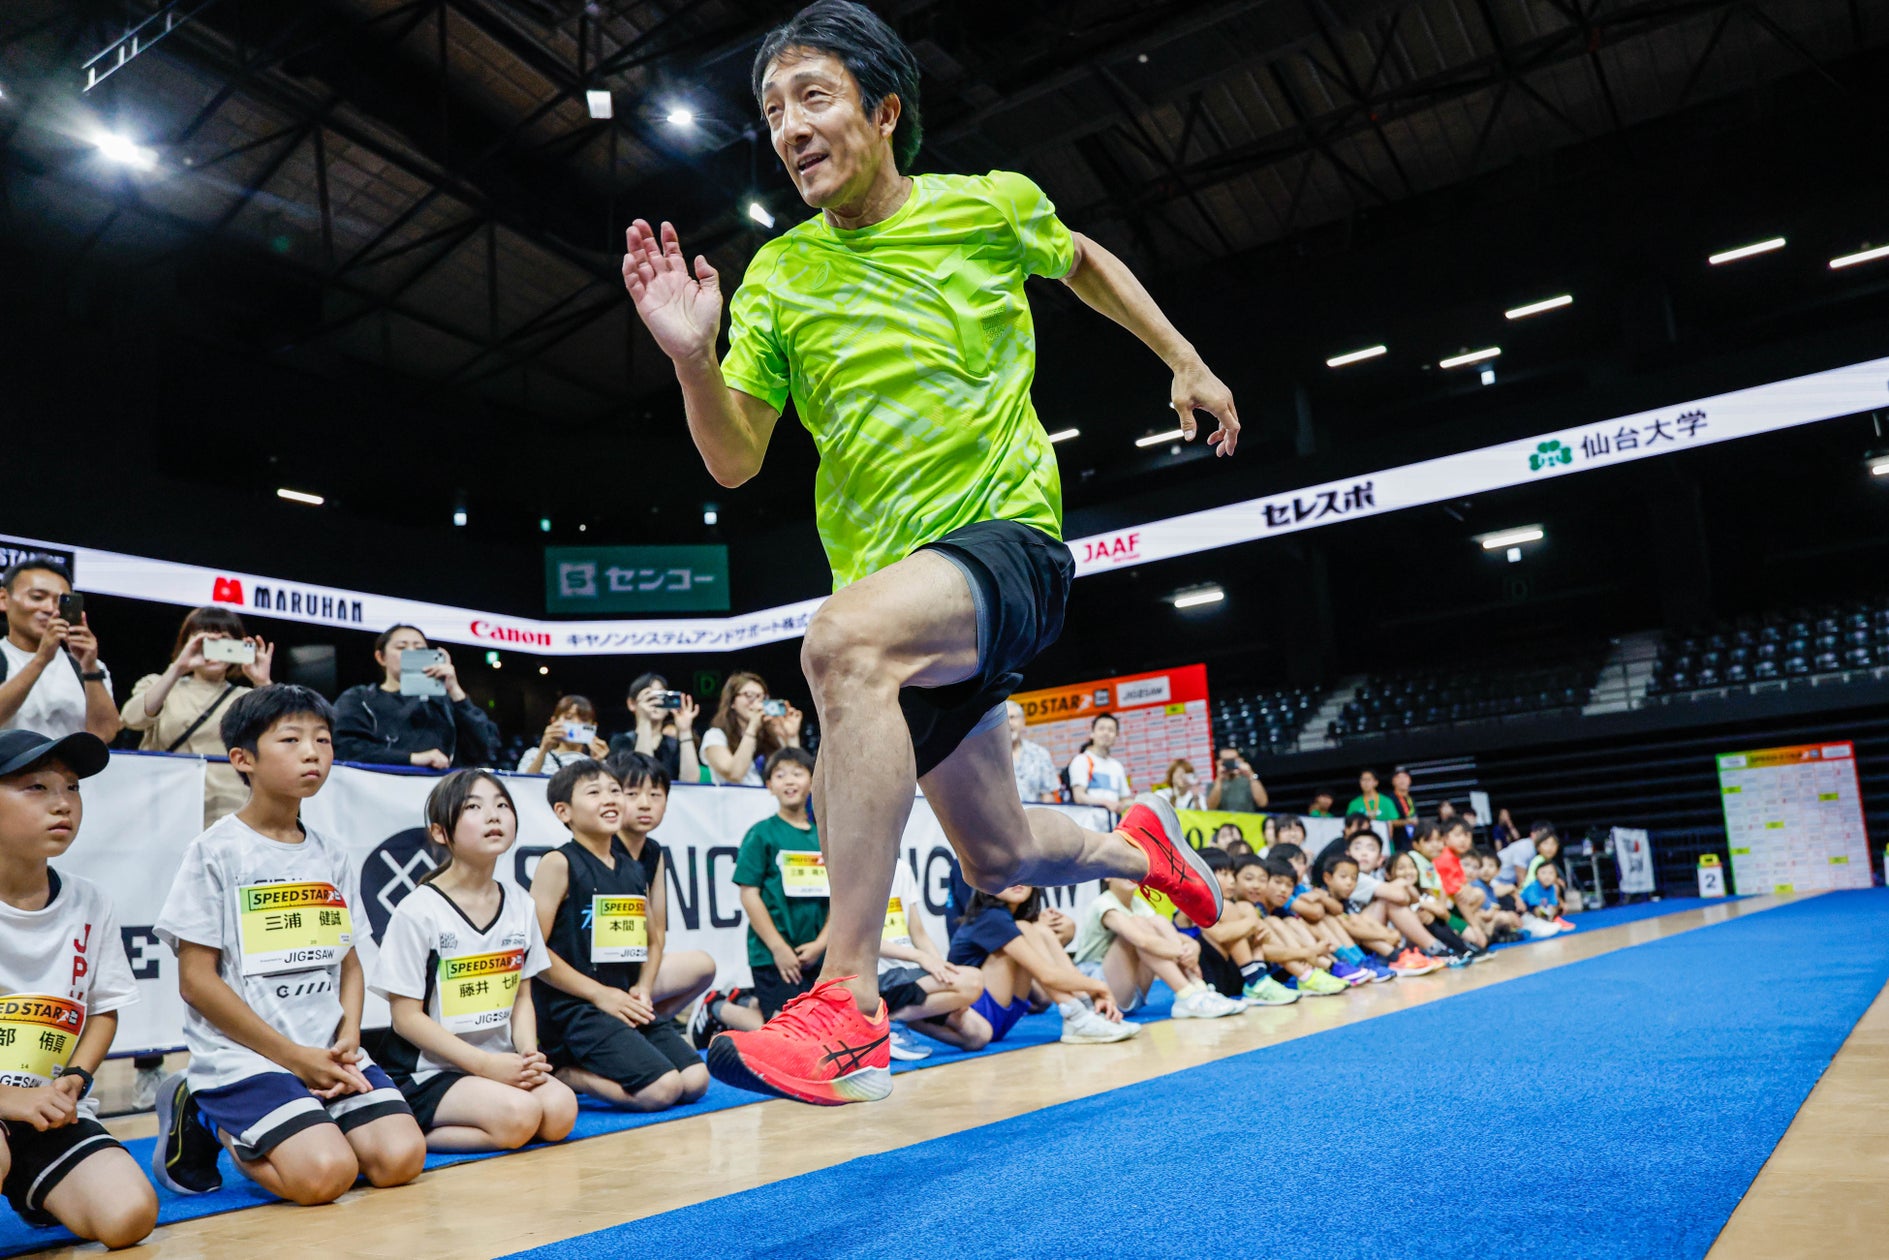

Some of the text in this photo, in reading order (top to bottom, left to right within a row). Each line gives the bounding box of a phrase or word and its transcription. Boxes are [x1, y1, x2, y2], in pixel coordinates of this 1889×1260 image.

[1580, 409, 1709, 459] 仙台大学
[1262, 481, 1376, 528] セレスポ
[1084, 533, 1140, 563] JAAF
[605, 566, 714, 591] センコー
[253, 585, 363, 623] MARUHAN
[470, 612, 816, 648] Canon キヤノンシステムアンドサポート株式
[1705, 873, 1716, 889] 2
[265, 912, 302, 932] 三浦
[609, 919, 635, 931] 本間
[458, 980, 489, 998] 藤井
